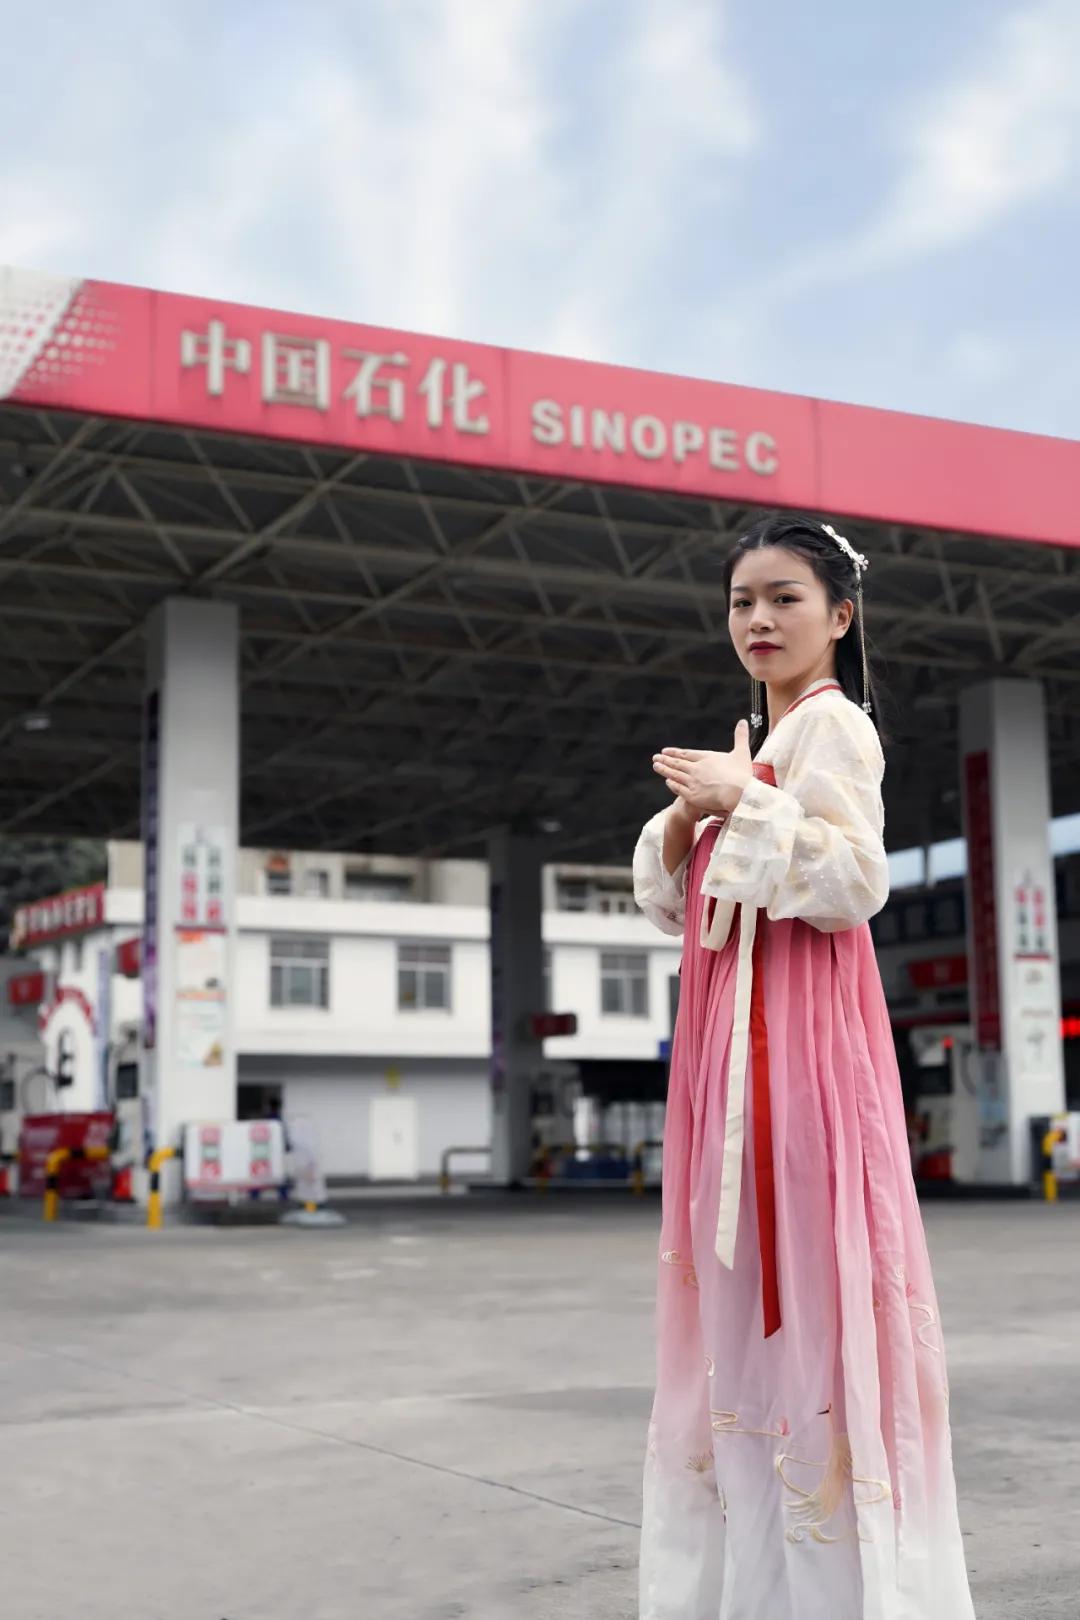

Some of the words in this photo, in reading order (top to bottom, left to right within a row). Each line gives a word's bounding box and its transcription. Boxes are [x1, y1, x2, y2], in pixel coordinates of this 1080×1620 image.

[180, 319, 490, 434] 中国石化
[530, 399, 778, 475] SINOPEC
